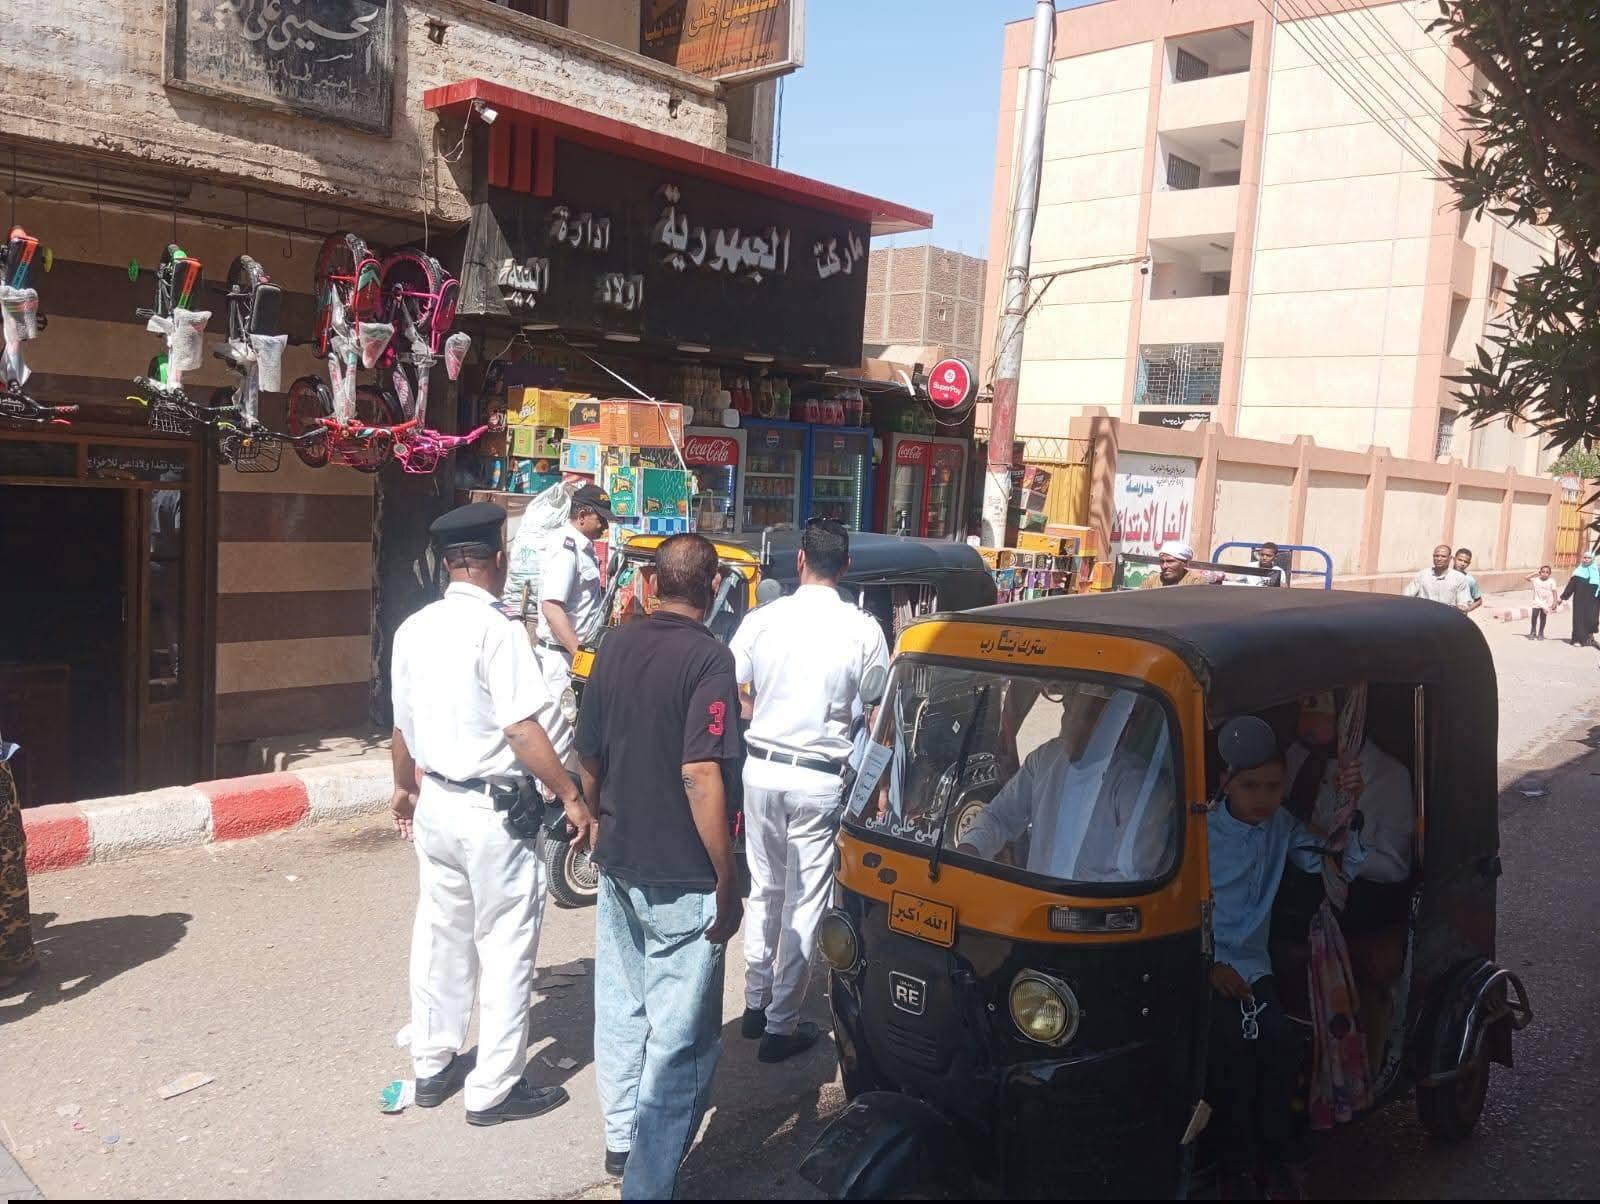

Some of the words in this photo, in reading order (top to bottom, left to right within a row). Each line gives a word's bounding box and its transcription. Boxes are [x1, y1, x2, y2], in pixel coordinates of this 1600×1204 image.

[556, 207, 610, 248] ادارة
[657, 184, 791, 283] الجمهورية
[813, 230, 863, 279] ماركت
[933, 381, 961, 396] SuperPay
[685, 438, 733, 462] Coca-Cola
[708, 700, 726, 736] 3
[923, 916, 948, 931] الله
[896, 985, 920, 1006] RE
